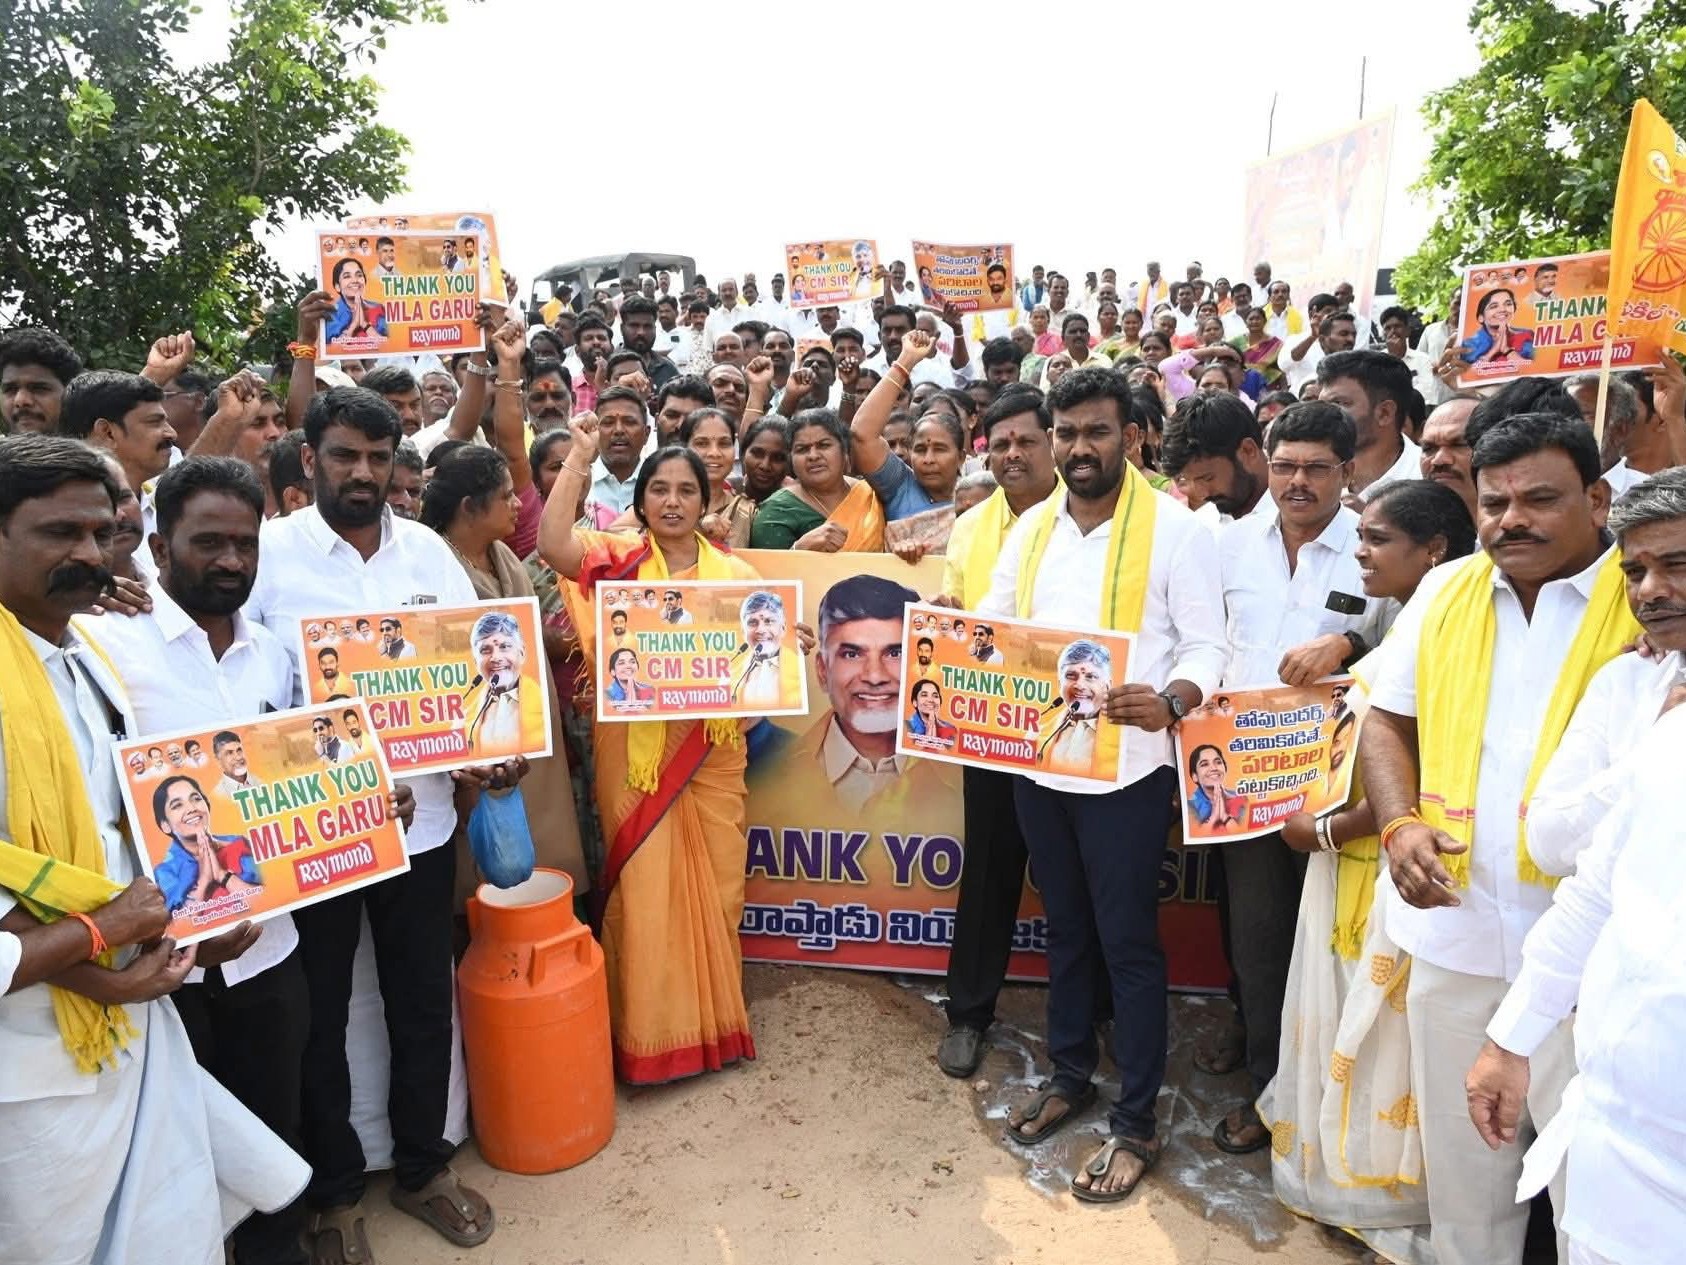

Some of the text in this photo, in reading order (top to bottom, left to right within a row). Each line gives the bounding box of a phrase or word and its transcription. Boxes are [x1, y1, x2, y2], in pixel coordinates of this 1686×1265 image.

[805, 263, 851, 275] THANK YOU
[810, 275, 849, 288] CM SIR
[381, 274, 475, 296] THANK YOU
[386, 298, 475, 322] MLA GARU
[1535, 297, 1608, 321] THANK
[411, 326, 461, 346] Raymond
[1534, 326, 1583, 347] MLA
[1563, 343, 1632, 367] Raymnd
[636, 631, 736, 652] THANK YOU
[352, 663, 468, 697] THANK YOU
[647, 656, 731, 680] CM SIR
[941, 666, 1051, 704] THANK YOU
[662, 687, 728, 709] Raymond
[369, 694, 465, 730] CM SIR
[950, 695, 1041, 733] CM SIR
[1235, 704, 1325, 729] తోపు బ్రదర్స్
[389, 731, 465, 762] Raymond
[962, 733, 1034, 760] Raymond
[1241, 747, 1324, 775] పరిటాల
[233, 760, 379, 822] THANK YOU
[1252, 795, 1303, 826] Raymond
[249, 794, 386, 864] MLA GARU
[299, 840, 374, 886] Raymond
[744, 828, 869, 884] ANK
[883, 833, 963, 890] YO
[232, 902, 249, 912] MLA
